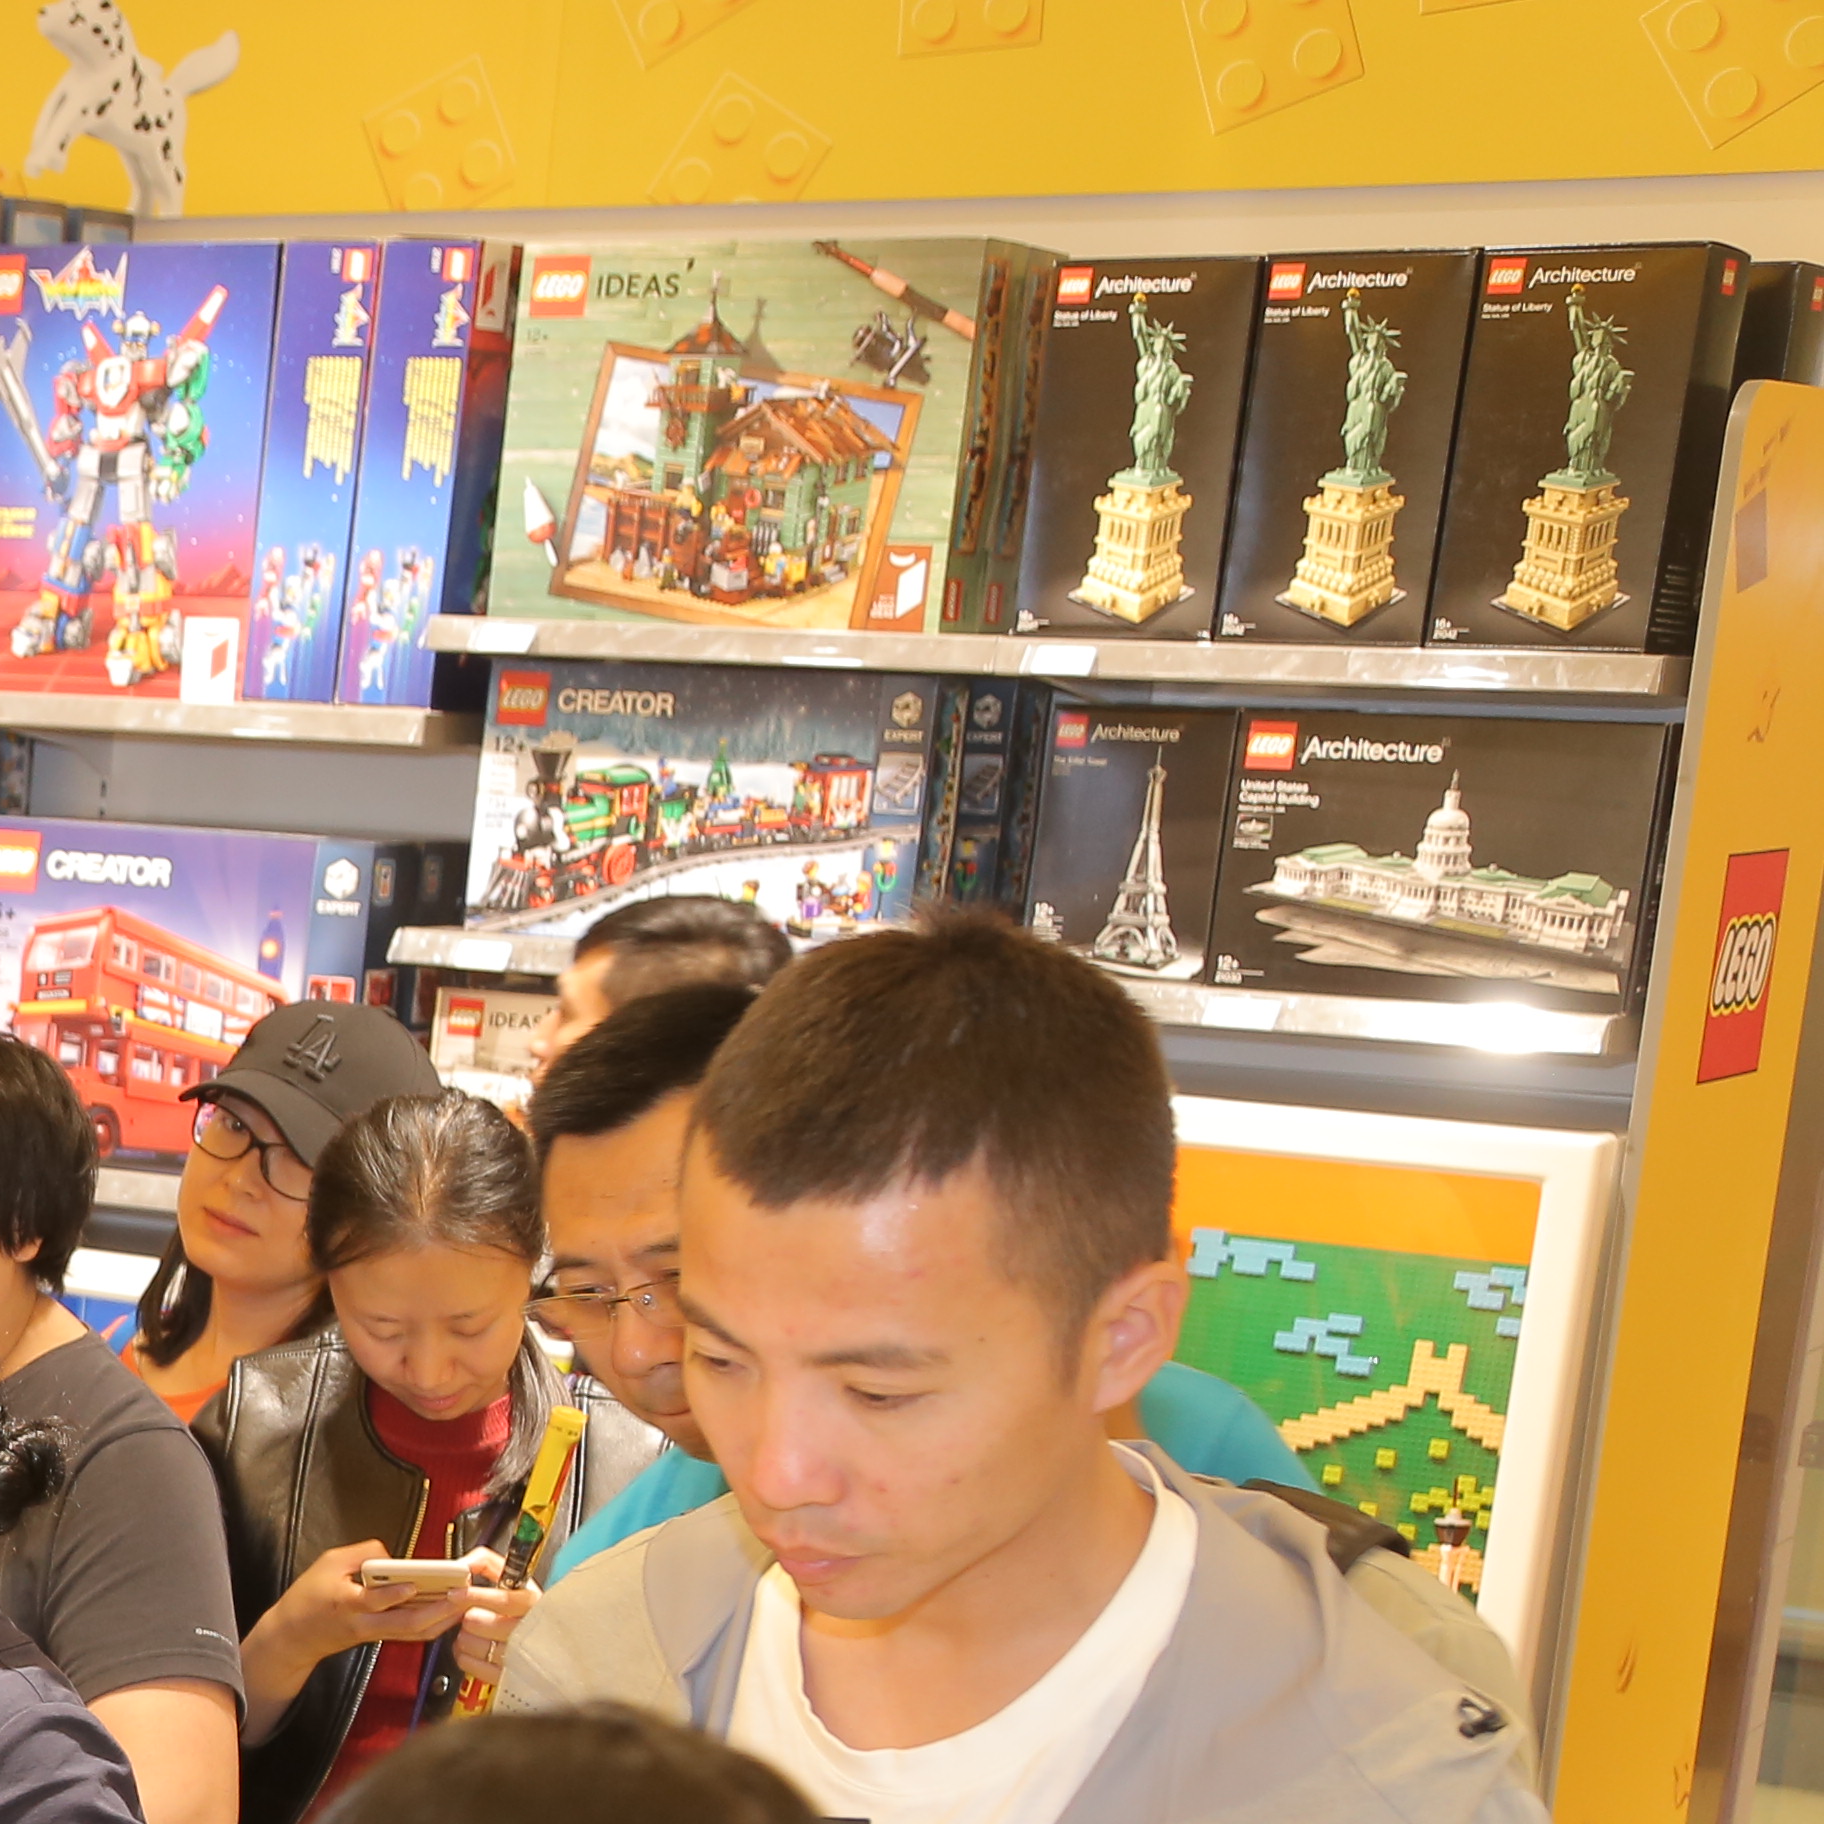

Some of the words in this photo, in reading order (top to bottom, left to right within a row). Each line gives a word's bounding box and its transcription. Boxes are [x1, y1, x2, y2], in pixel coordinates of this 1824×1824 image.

[534, 272, 586, 301] LEGO
[597, 273, 681, 298] IDEAS
[1095, 274, 1194, 299] Architecture
[1307, 271, 1409, 294] Architecture
[1485, 266, 1525, 286] LEGO
[1529, 266, 1636, 289] Architecture
[1483, 303, 1511, 314] Statue
[1522, 302, 1553, 313] Liberty
[502, 685, 548, 711] LEGO
[558, 687, 675, 718] CREATOR
[494, 734, 525, 752] 12+
[884, 728, 925, 744] EXPERT
[1090, 721, 1181, 743] Architecture
[1247, 733, 1295, 756] LEGO
[1300, 735, 1444, 765] Architecture
[1240, 779, 1274, 793] United
[1276, 780, 1310, 793] States
[1238, 791, 1277, 805] Capitol
[1277, 792, 1321, 810] Building
[46, 849, 173, 888] CREATOR
[315, 900, 361, 916] EXPERT
[1713, 916, 1775, 1010] LEGO
